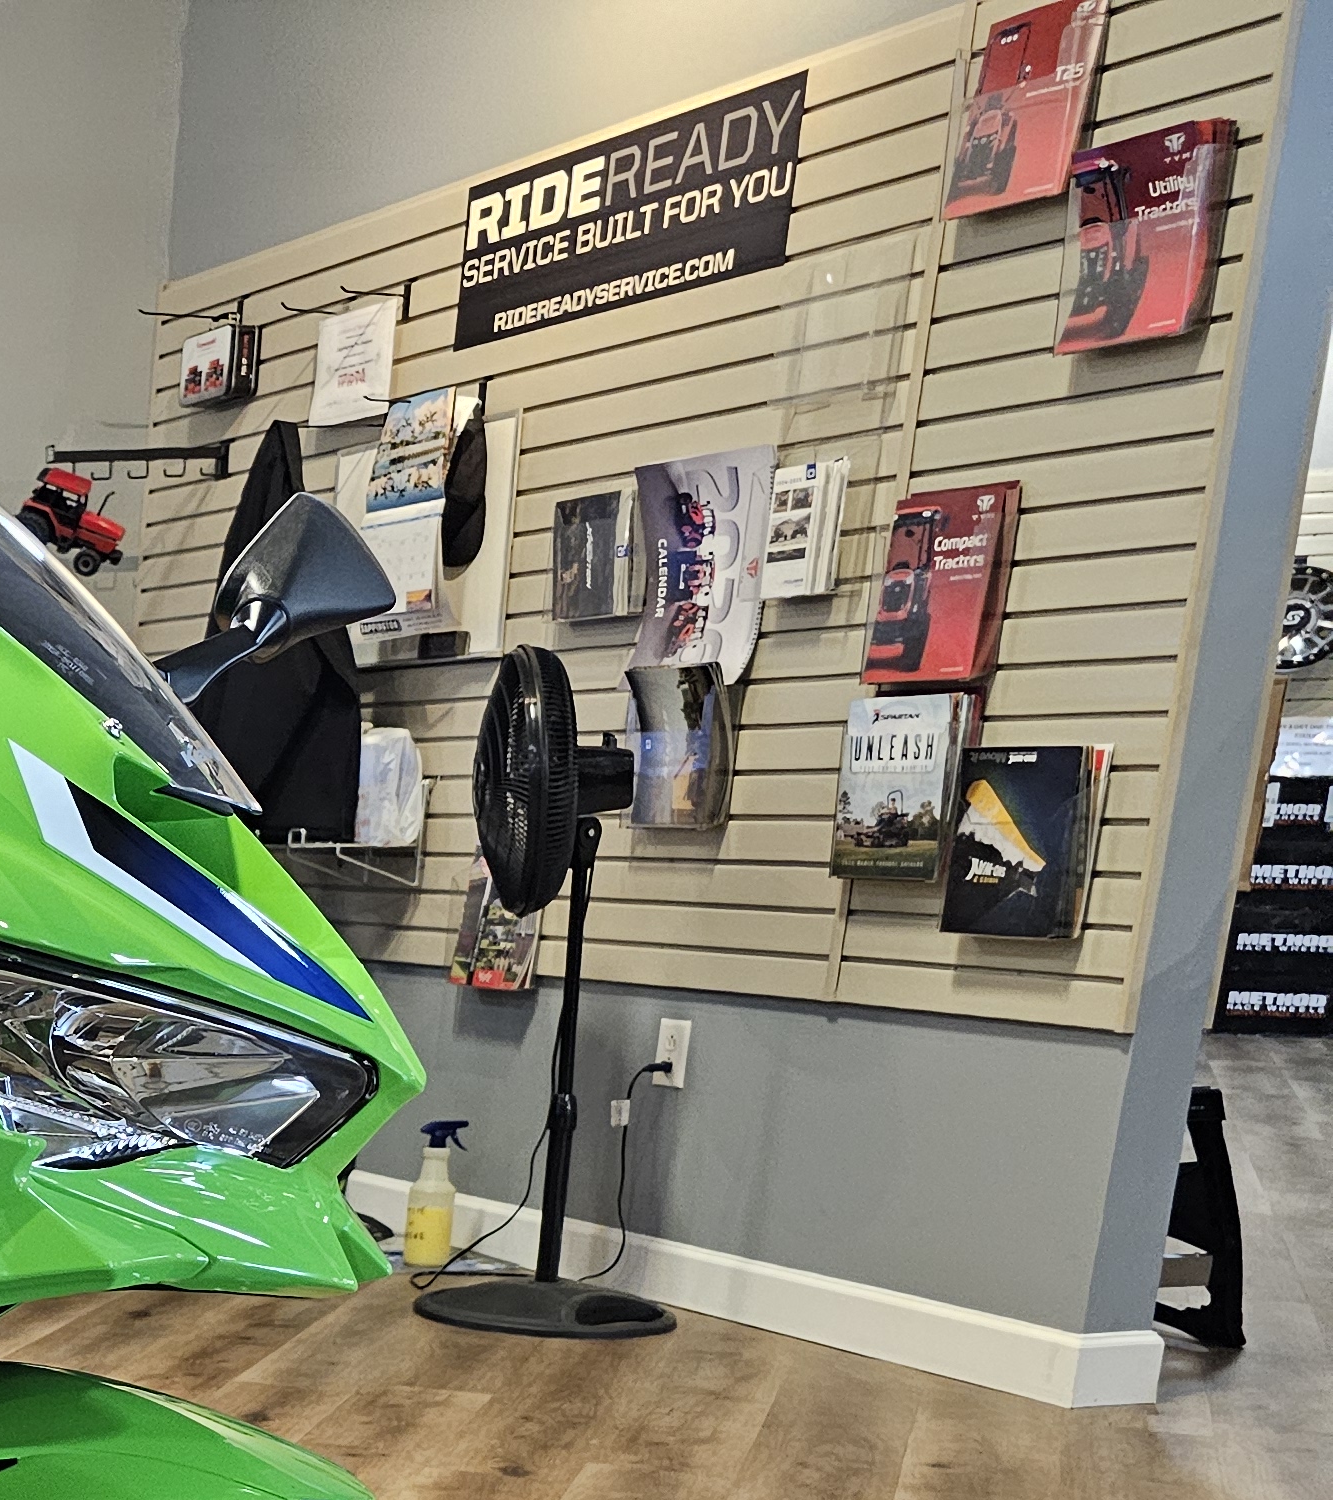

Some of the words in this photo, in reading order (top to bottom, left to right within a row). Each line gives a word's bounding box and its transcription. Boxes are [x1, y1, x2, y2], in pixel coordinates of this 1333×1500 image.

[1055, 62, 1085, 82] T25
[1148, 174, 1194, 198] Utility
[1134, 197, 1198, 223] Tractors
[462, 226, 571, 288] SERVICE
[576, 202, 658, 254] BUILT
[662, 182, 722, 231] FOR
[727, 161, 795, 213] YOU
[492, 248, 735, 335] RIDEREADYSERVICE.COM
[933, 533, 988, 552] Compact
[933, 554, 986, 571] Tractors
[654, 538, 669, 619] CALENDAR
[854, 733, 935, 762] UNLEASH
[1227, 990, 1327, 1007] METHOD
